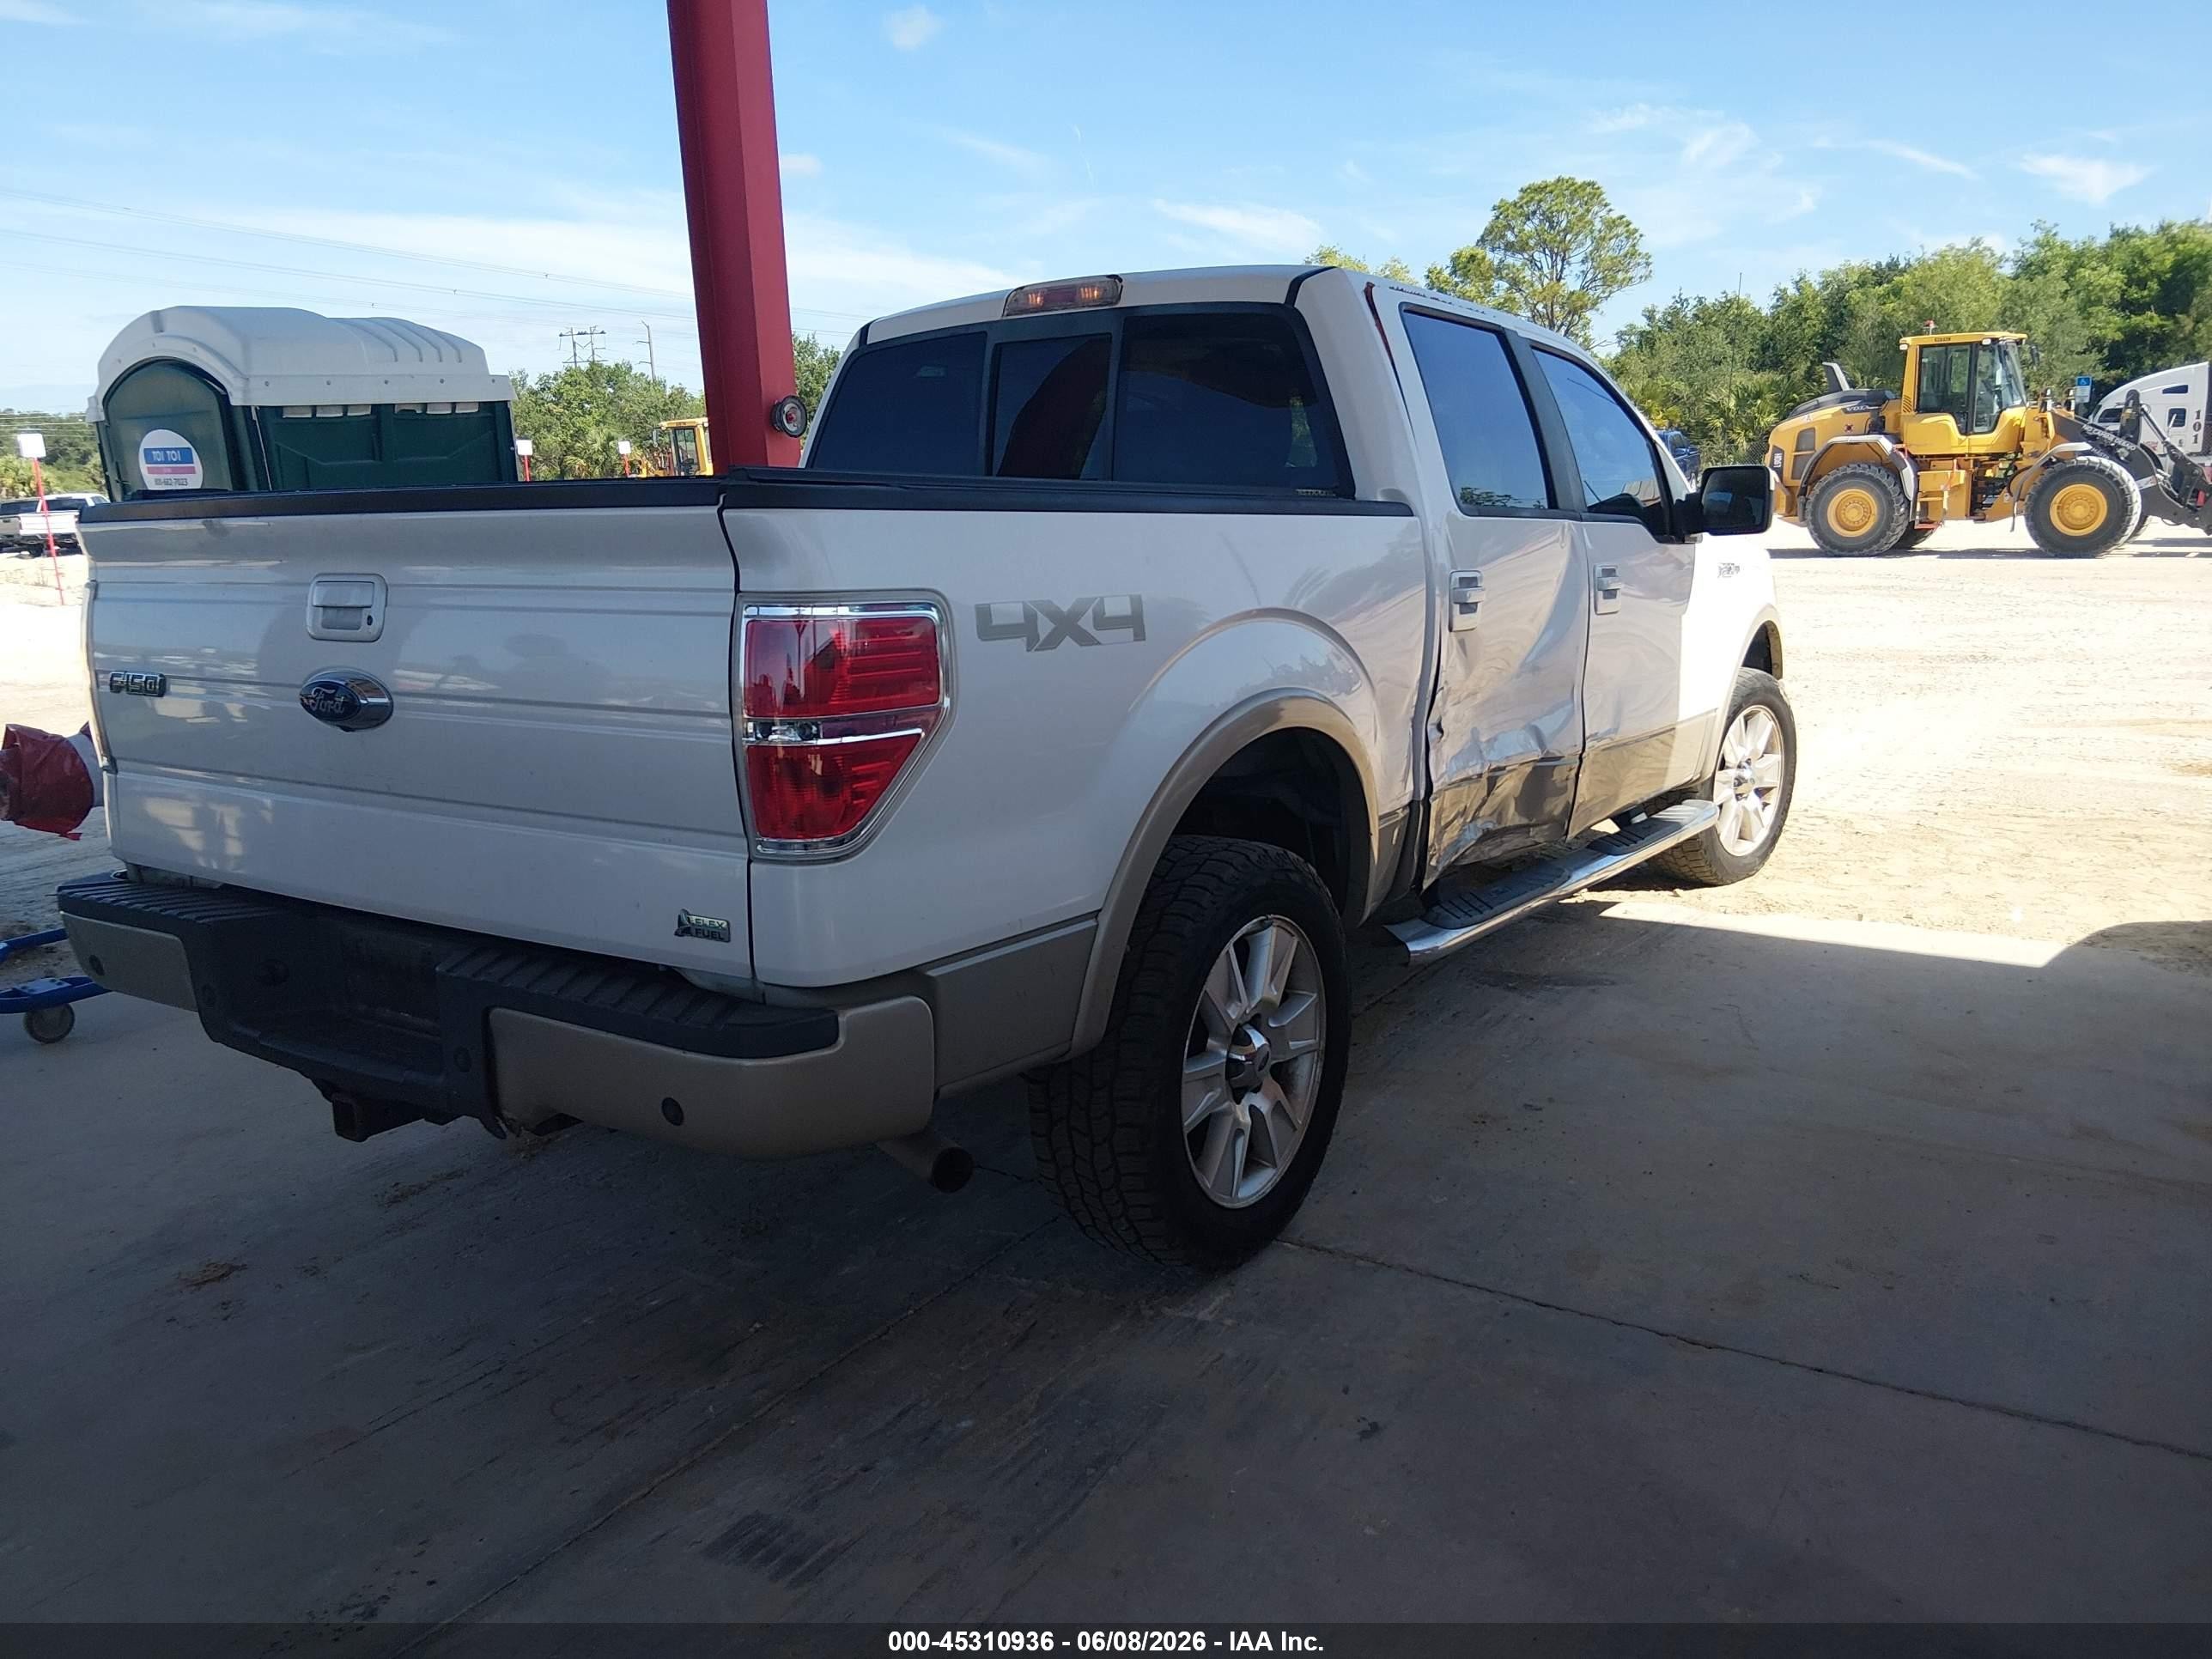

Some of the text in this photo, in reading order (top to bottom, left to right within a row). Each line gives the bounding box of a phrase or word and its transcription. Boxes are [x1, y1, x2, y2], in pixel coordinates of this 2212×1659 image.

[2192, 410, 2203, 444] 101
[151, 450, 181, 462] TOI TOI
[307, 686, 345, 714] Ford
[695, 917, 726, 929] FLEX
[695, 928, 725, 941] FUEL
